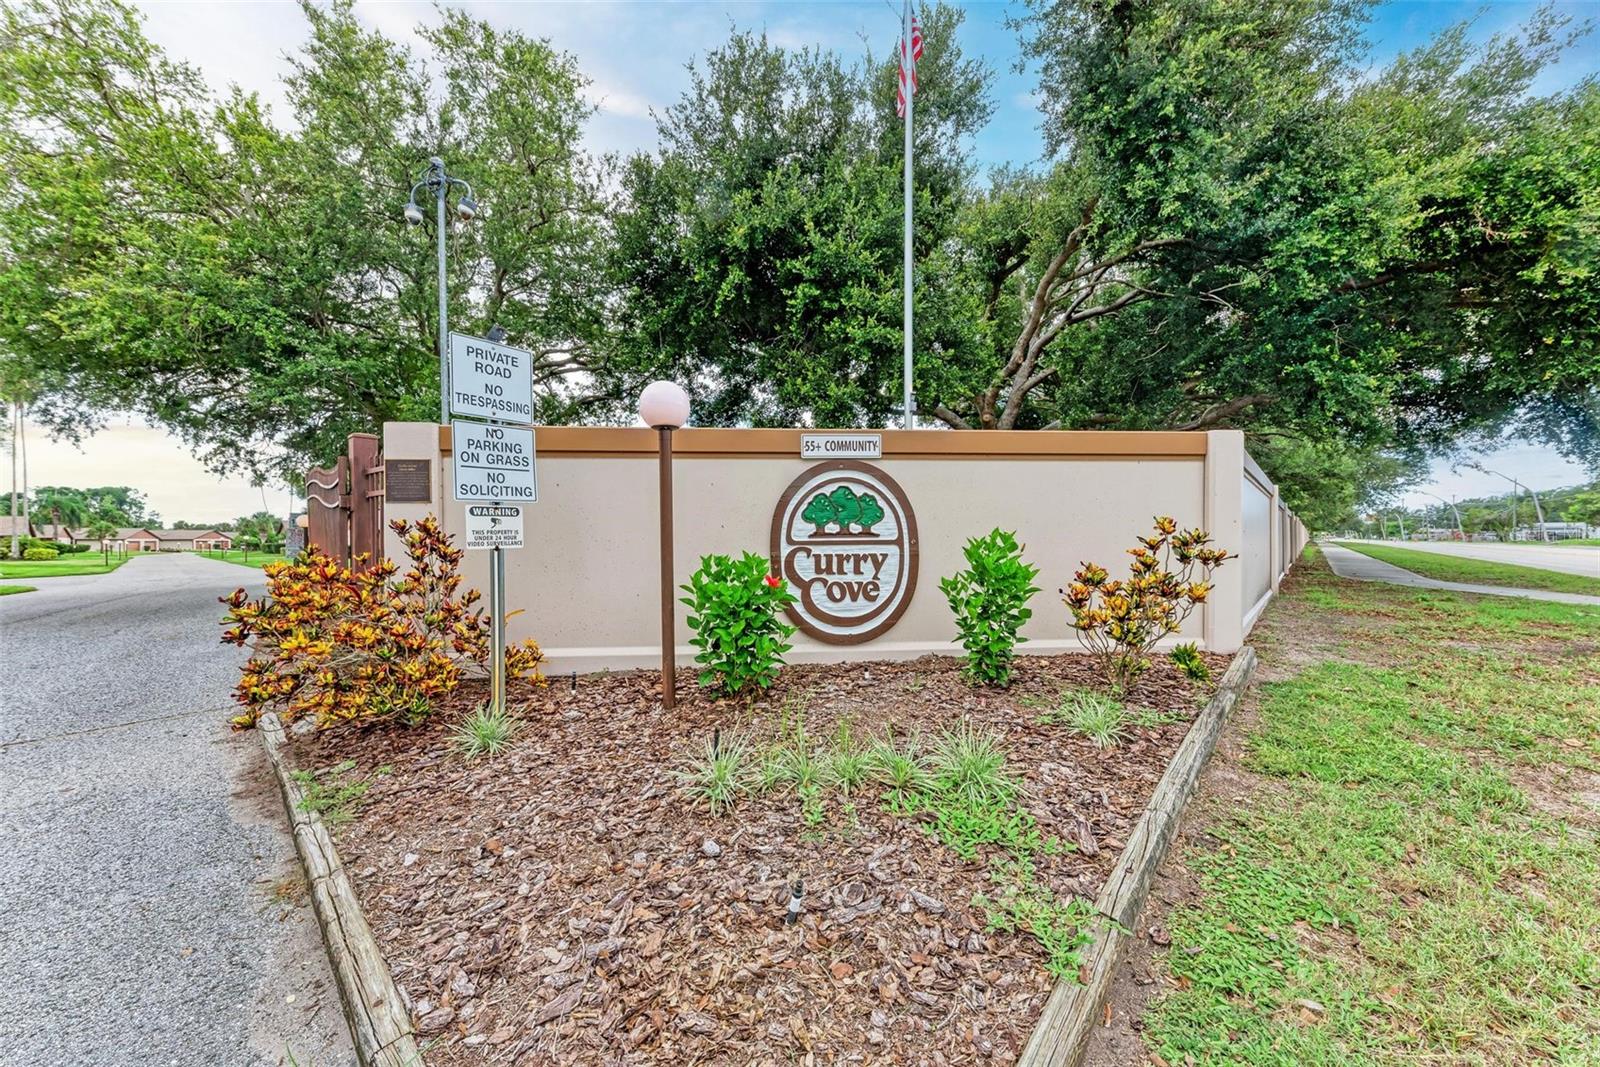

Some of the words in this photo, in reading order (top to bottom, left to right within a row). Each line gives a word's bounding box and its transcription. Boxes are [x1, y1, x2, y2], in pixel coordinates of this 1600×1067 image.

[466, 345, 519, 368] PRIVATE
[475, 361, 512, 379] ROAD
[485, 383, 503, 397] NO
[455, 392, 530, 415] TRESPASSING
[485, 427, 504, 440] NO
[467, 438, 523, 454] PARKING
[804, 440, 822, 452] 55+
[824, 439, 878, 452] COMMUNITY
[460, 451, 480, 463] ON
[486, 453, 530, 467] GRASS
[487, 472, 506, 484] NO
[460, 483, 533, 498] SOLICITING
[472, 507, 518, 516] WARNING
[784, 546, 889, 581] Curry
[801, 577, 880, 604] Cove
